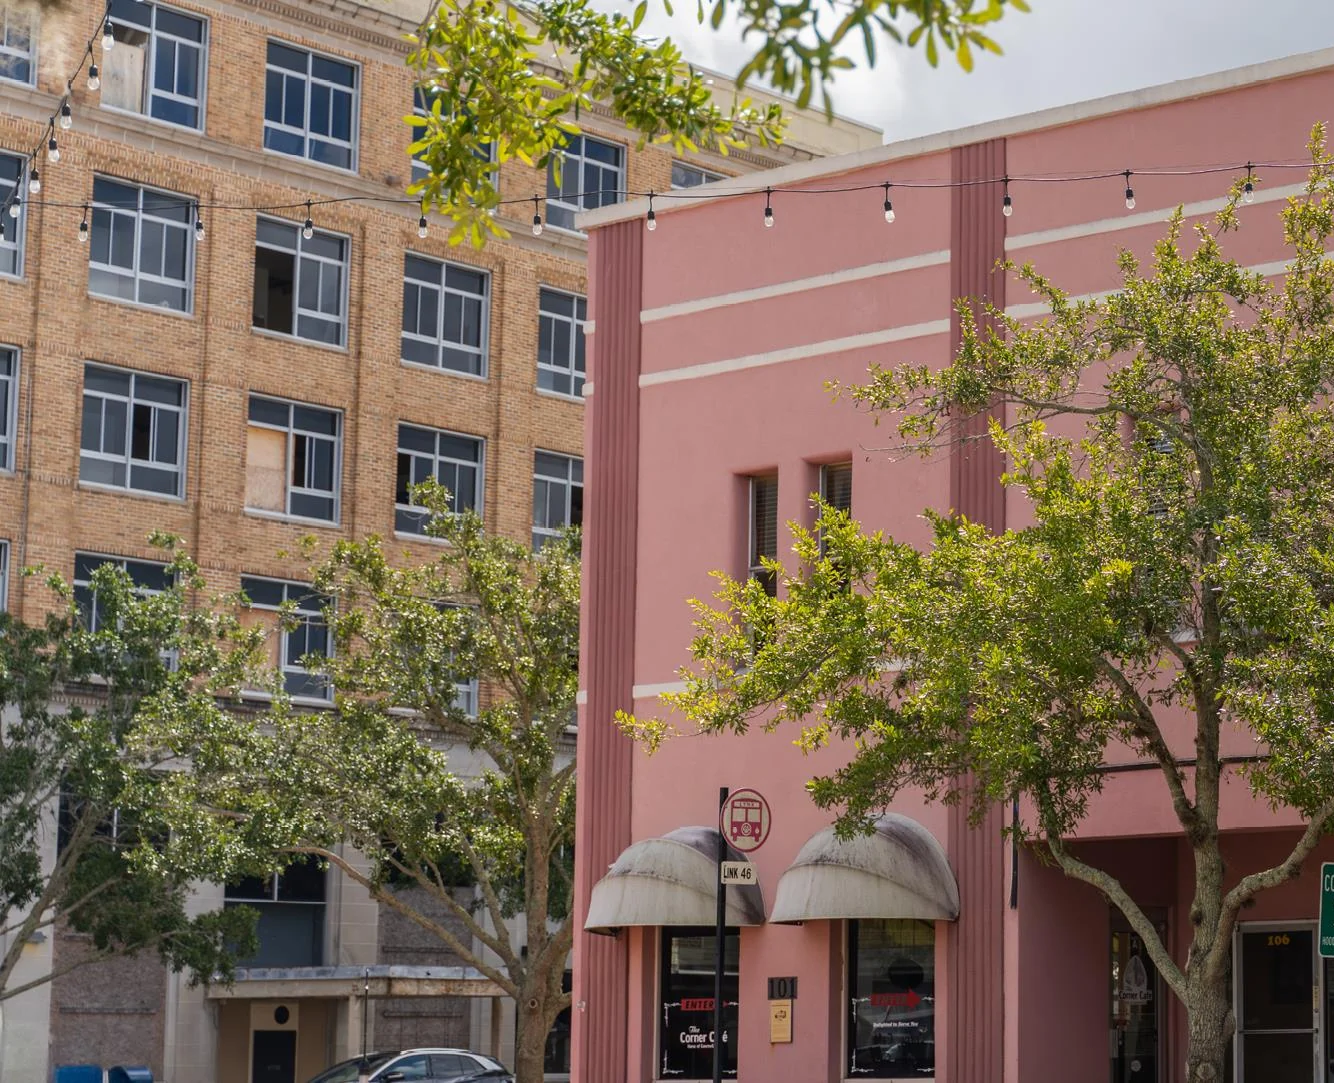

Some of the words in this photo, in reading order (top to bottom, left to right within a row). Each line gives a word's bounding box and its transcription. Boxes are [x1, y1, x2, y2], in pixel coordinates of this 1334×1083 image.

[723, 867, 739, 879] LINK
[740, 868, 752, 880] 46
[1267, 935, 1290, 946] 106
[769, 978, 795, 999] 101
[1118, 991, 1138, 1000] Corner
[685, 1000, 714, 1010] ENTER
[680, 1031, 707, 1043] Corner
[709, 1030, 728, 1042] Cé
